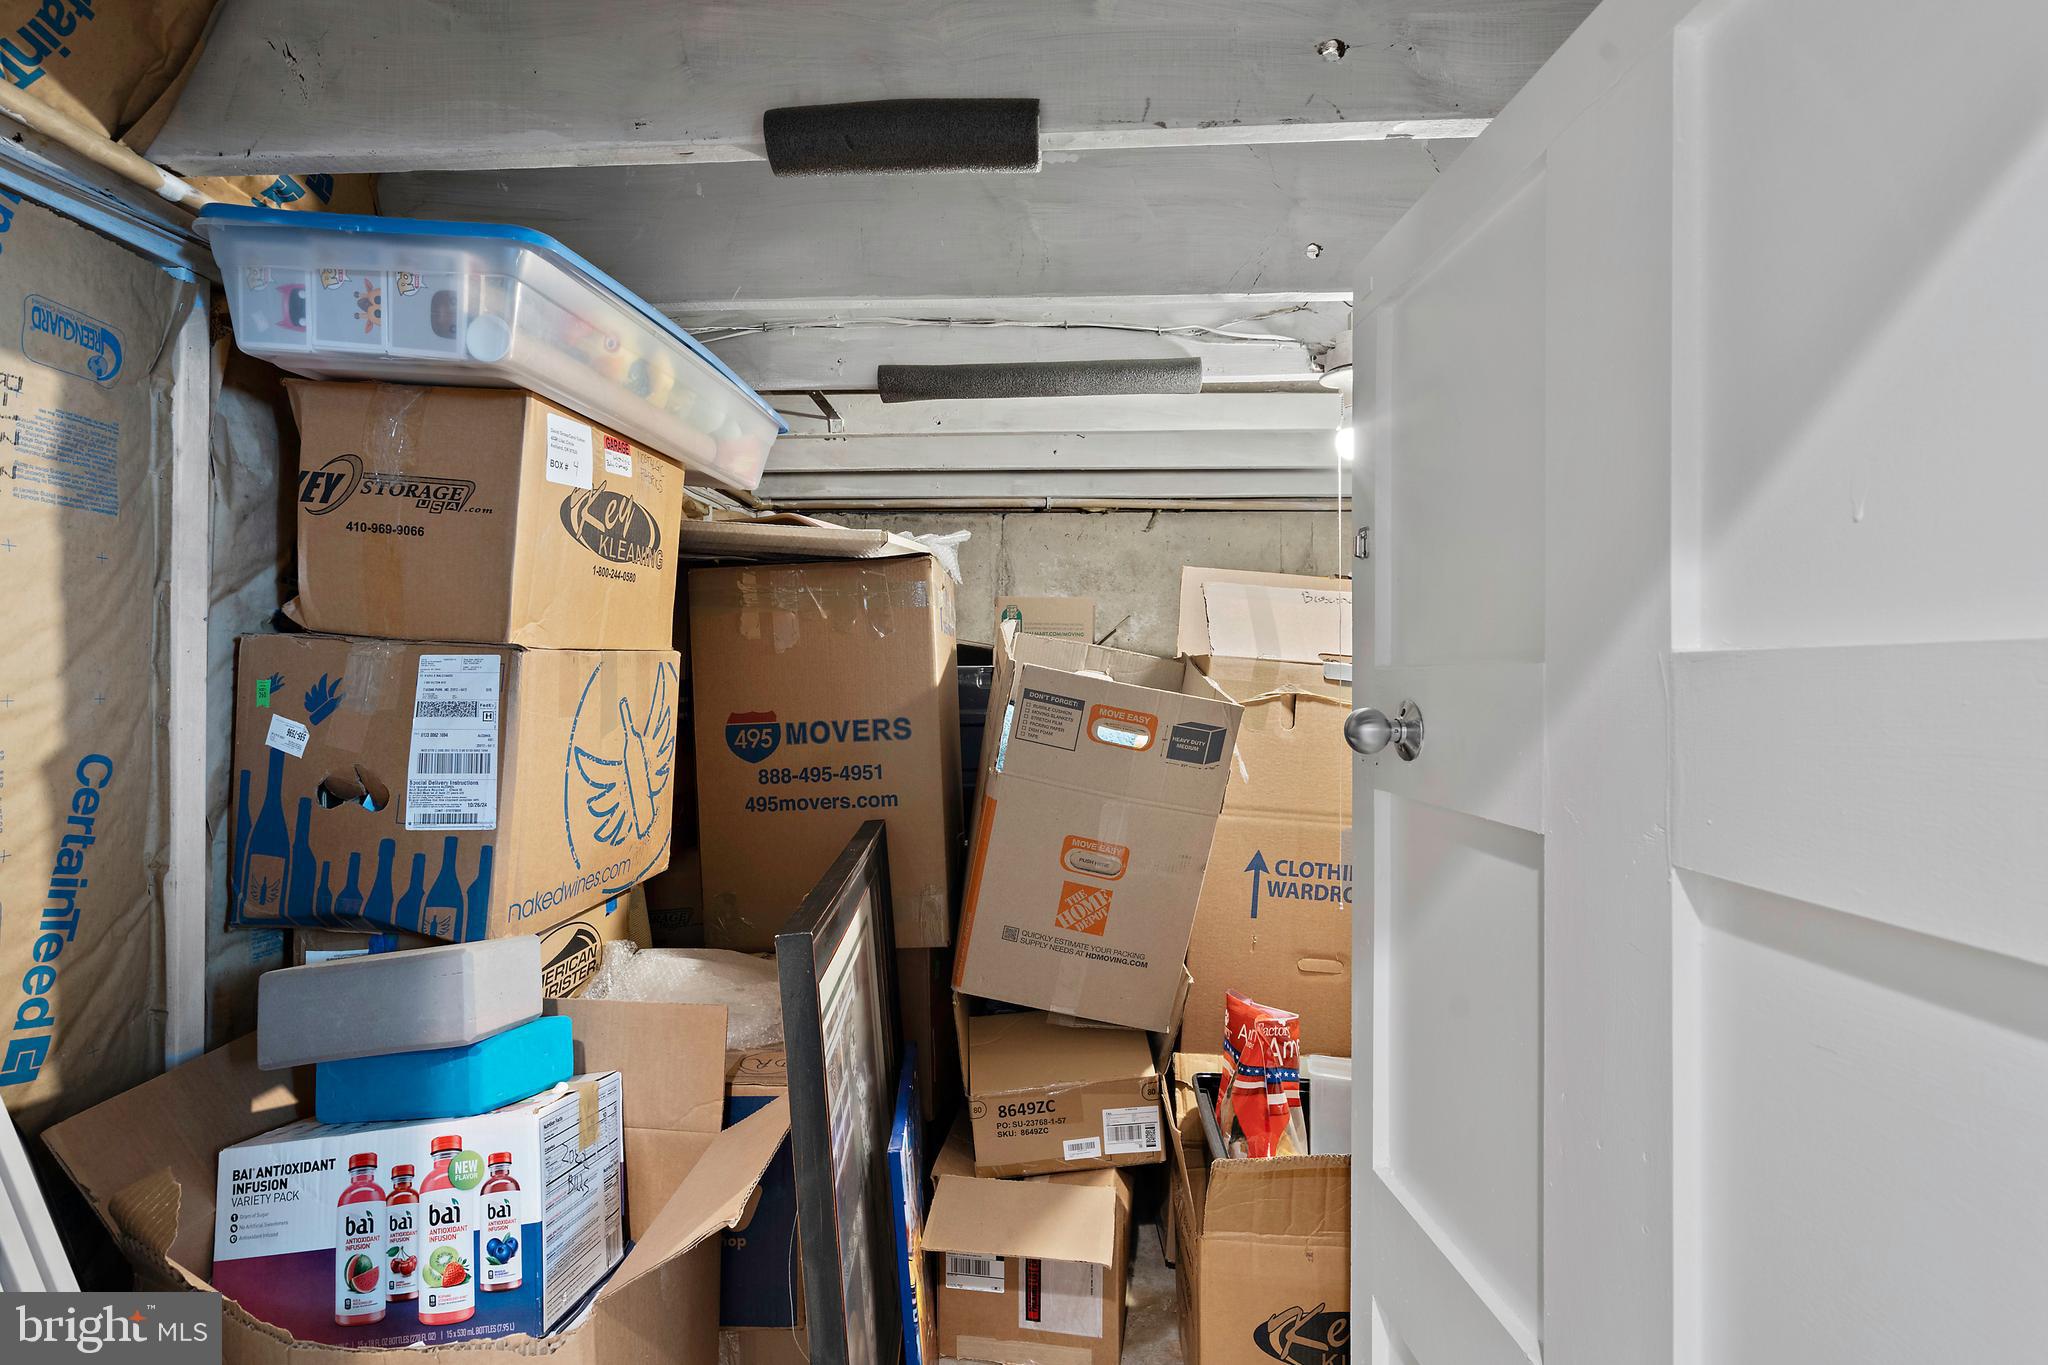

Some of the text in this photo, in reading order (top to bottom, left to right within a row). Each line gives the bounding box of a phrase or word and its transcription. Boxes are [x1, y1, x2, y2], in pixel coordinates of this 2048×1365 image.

[549, 459, 563, 470] BOX
[360, 480, 464, 501] STORAGE
[345, 521, 425, 537] 410-969-9066
[1100, 708, 1152, 724] MOVE EASY
[733, 717, 912, 750] 495 MOVERS
[1176, 743, 1200, 752] MEDIUM
[1190, 739, 1206, 747] DUTY
[758, 763, 883, 785] 888-495-4951
[745, 794, 898, 813] 495movers.com
[1072, 838, 1097, 849] MOVE
[1274, 859, 1352, 881] CLOTHI
[13, 753, 113, 1031] CertainTeed
[507, 858, 632, 923] nakedwines.com
[1064, 889, 1088, 906] THE
[1057, 889, 1111, 928] HOME
[1074, 907, 1108, 931] DEPOT
[1019, 938, 1049, 950] SUPPLY
[1049, 944, 1074, 956] NEEDS
[1085, 951, 1149, 969] HDMOVING.COM
[1021, 929, 1146, 961] QUICKLY ESTIMATE YOUR PACKING
[542, 944, 598, 988] ERICAN
[998, 1099, 1056, 1118] 8649ZC
[1012, 1117, 1066, 1128] SU-23768-1-57
[997, 1127, 1049, 1138] SKU: 8649ZC
[232, 1158, 336, 1181] BAI ANTIOXIDANT
[454, 1159, 478, 1174] NEW
[454, 1172, 478, 1181] FLAVOR
[232, 1178, 288, 1195] INFUSION
[231, 1190, 300, 1207] VARIETY PACK
[429, 1199, 461, 1226] bai
[487, 1200, 511, 1220] bai
[345, 1211, 374, 1236] bai
[389, 1211, 413, 1231] bai
[429, 1224, 468, 1235] ANTIOXIDANT
[487, 1219, 517, 1227] ANTIOXIDANT
[487, 1225, 509, 1233] INFUSION
[345, 1235, 380, 1245] ANTIOXIDANT
[345, 1243, 371, 1251] INFUSION
[429, 1234, 457, 1243] INFUSION
[388, 1336, 410, 1346] BOTTLES
[456, 1329, 466, 1337] 530
[475, 1325, 496, 1334] BOTTLES
